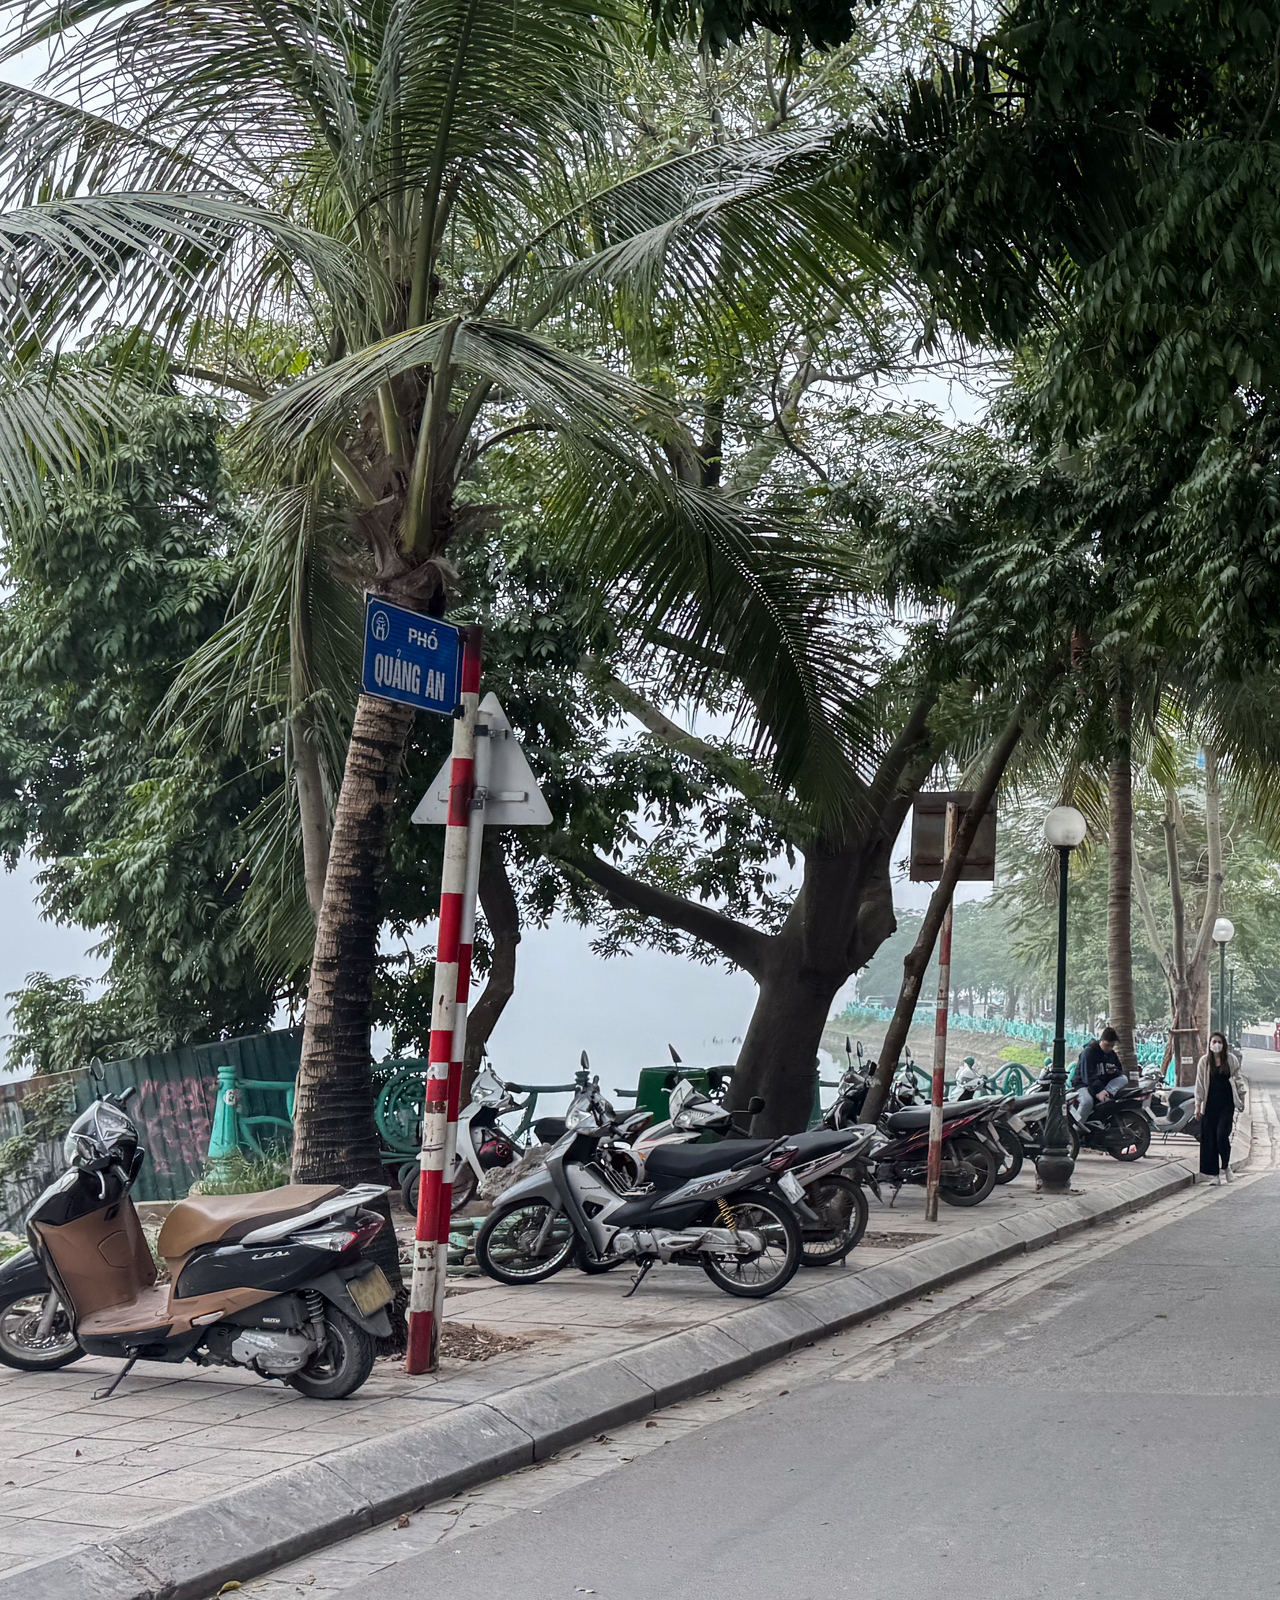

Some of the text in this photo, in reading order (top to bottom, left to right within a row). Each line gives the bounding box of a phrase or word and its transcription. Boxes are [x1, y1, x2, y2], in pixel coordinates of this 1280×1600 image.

[408, 627, 439, 651] PHỐ
[374, 648, 446, 702] QUẢNG AN
